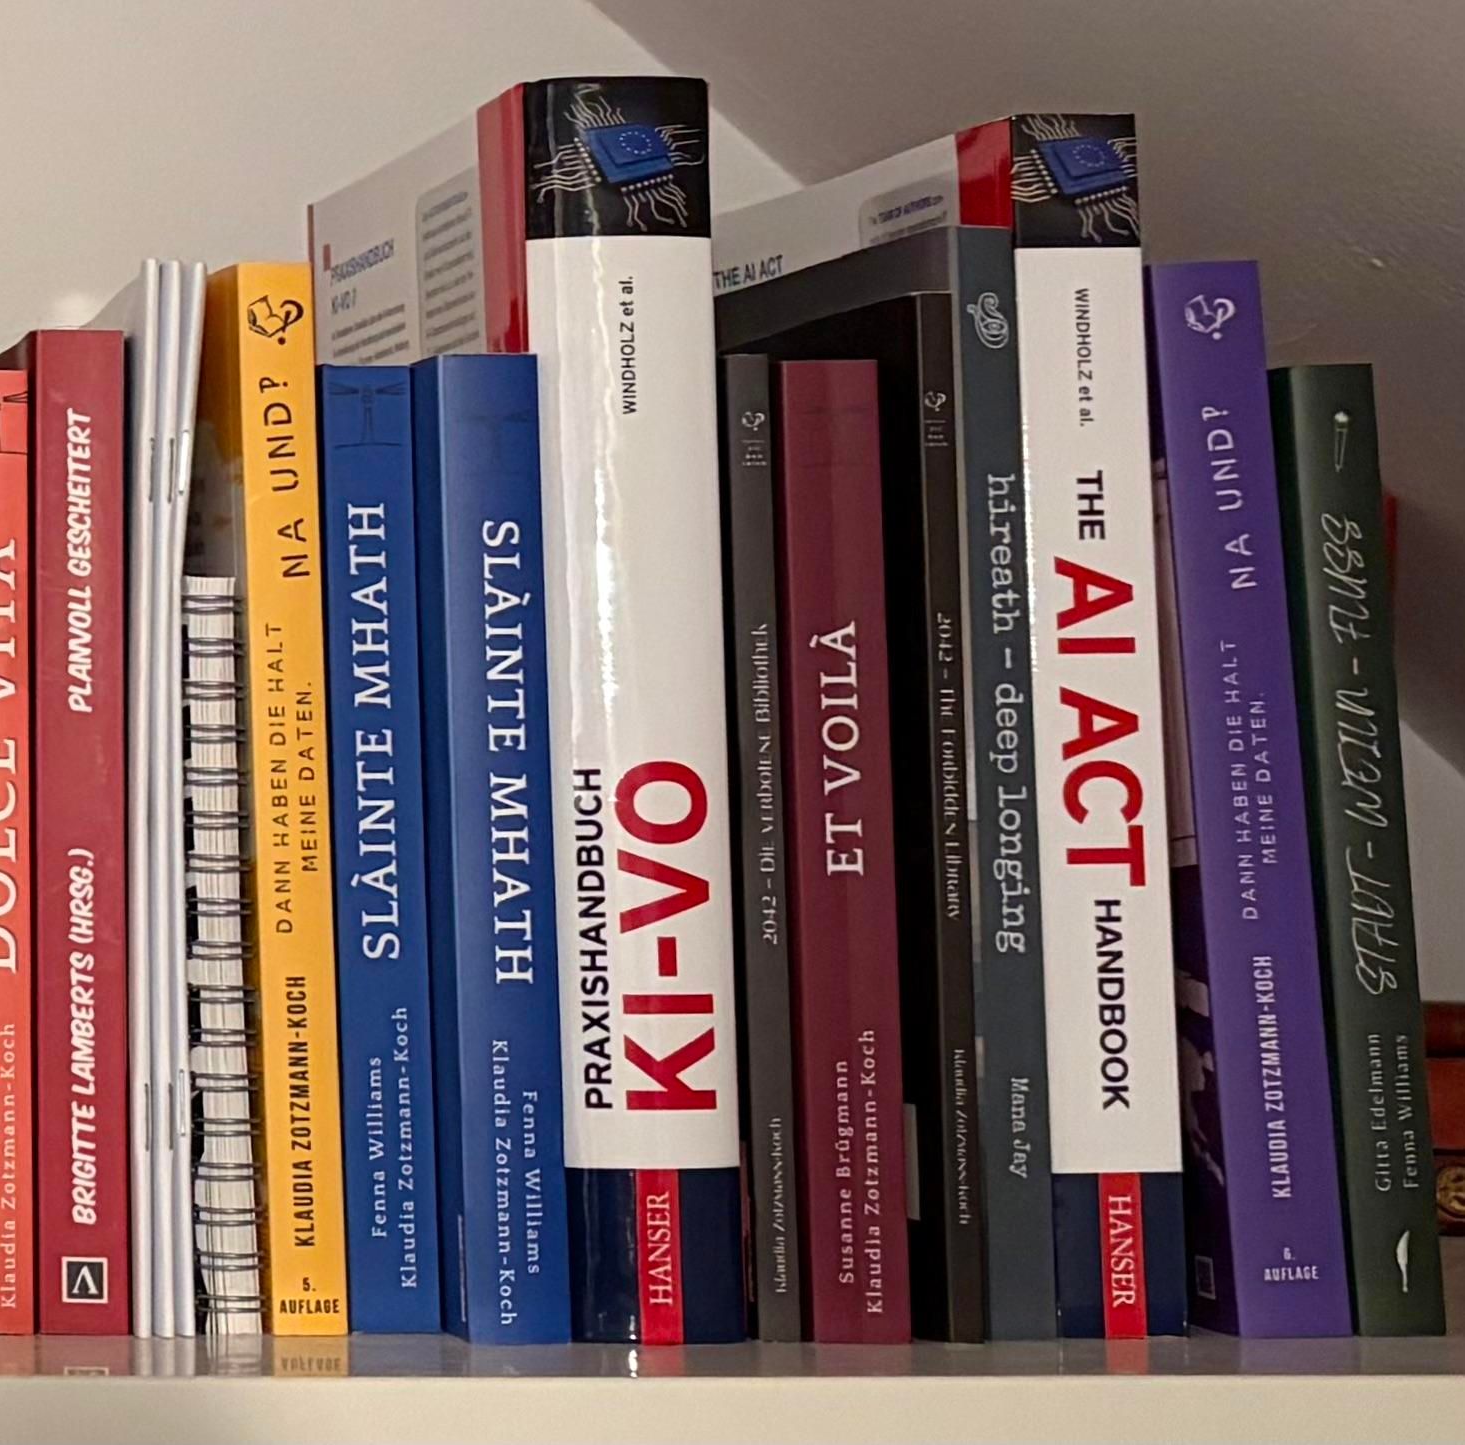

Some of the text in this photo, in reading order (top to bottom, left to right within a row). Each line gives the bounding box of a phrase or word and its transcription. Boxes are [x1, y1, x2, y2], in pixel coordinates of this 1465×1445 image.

[619, 277, 636, 414] WINDHOLZ et al.
[65, 408, 96, 715] PLANVOLL GESCHEITERT
[988, 470, 1021, 634] hireath
[348, 503, 399, 958] SLÀINTE MHATH
[810, 621, 863, 875] ET VOILÀ
[989, 684, 1024, 773] deep
[1054, 470, 1146, 1109] THE AI ACT HANDBOOK
[574, 769, 612, 1108] PRAXISHANDBUCH
[610, 761, 716, 1115] KI-VO
[993, 786, 1029, 952] longing
[67, 847, 97, 1227] BRIGITTE LAMBERTS (HRSG.)
[523, 1091, 543, 1273] Fenna Williams
[647, 1192, 672, 1304] HANSER
